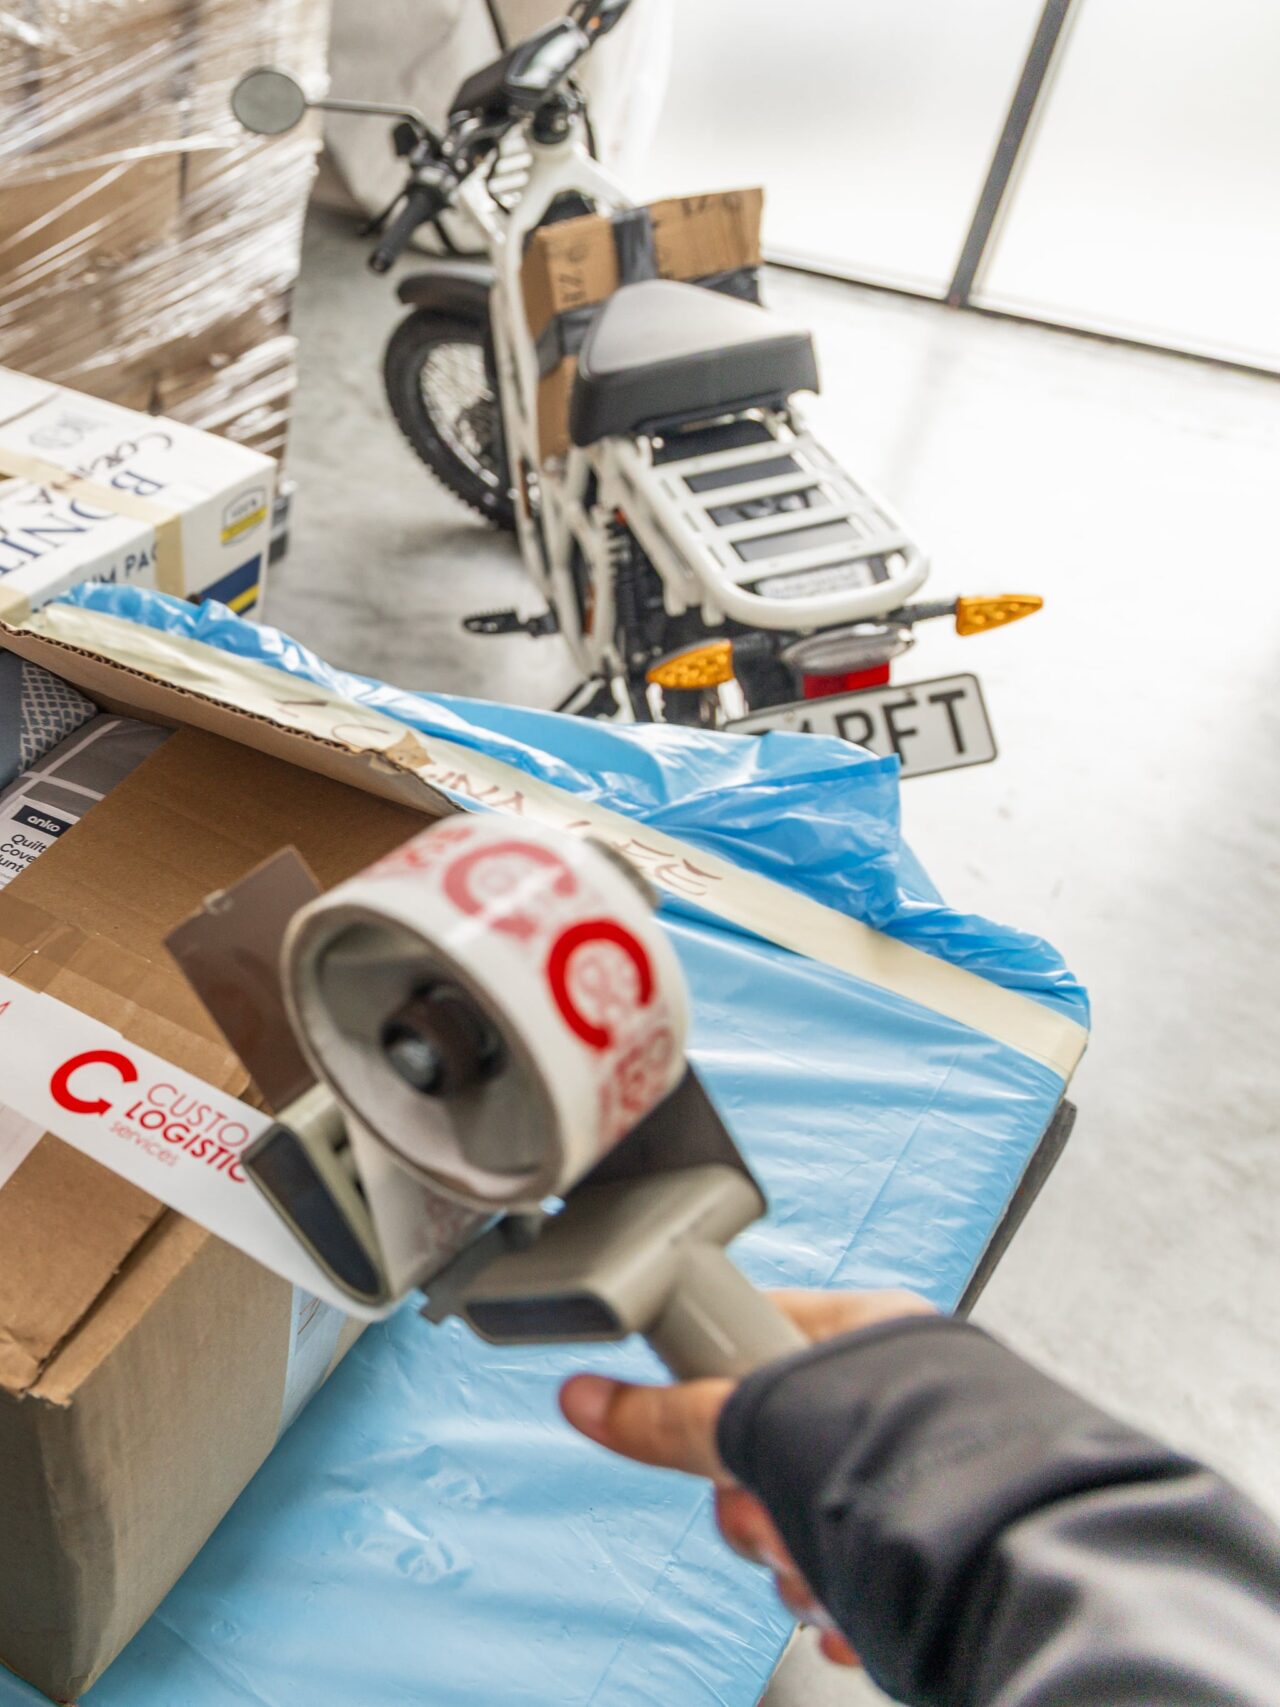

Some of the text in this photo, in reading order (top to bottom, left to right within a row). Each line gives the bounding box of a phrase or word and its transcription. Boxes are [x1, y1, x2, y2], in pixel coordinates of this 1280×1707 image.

[27, 816, 60, 832] anko
[11, 834, 47, 853] Quilt
[147, 1083, 253, 1149] CUSTO
[109, 1120, 181, 1168] services
